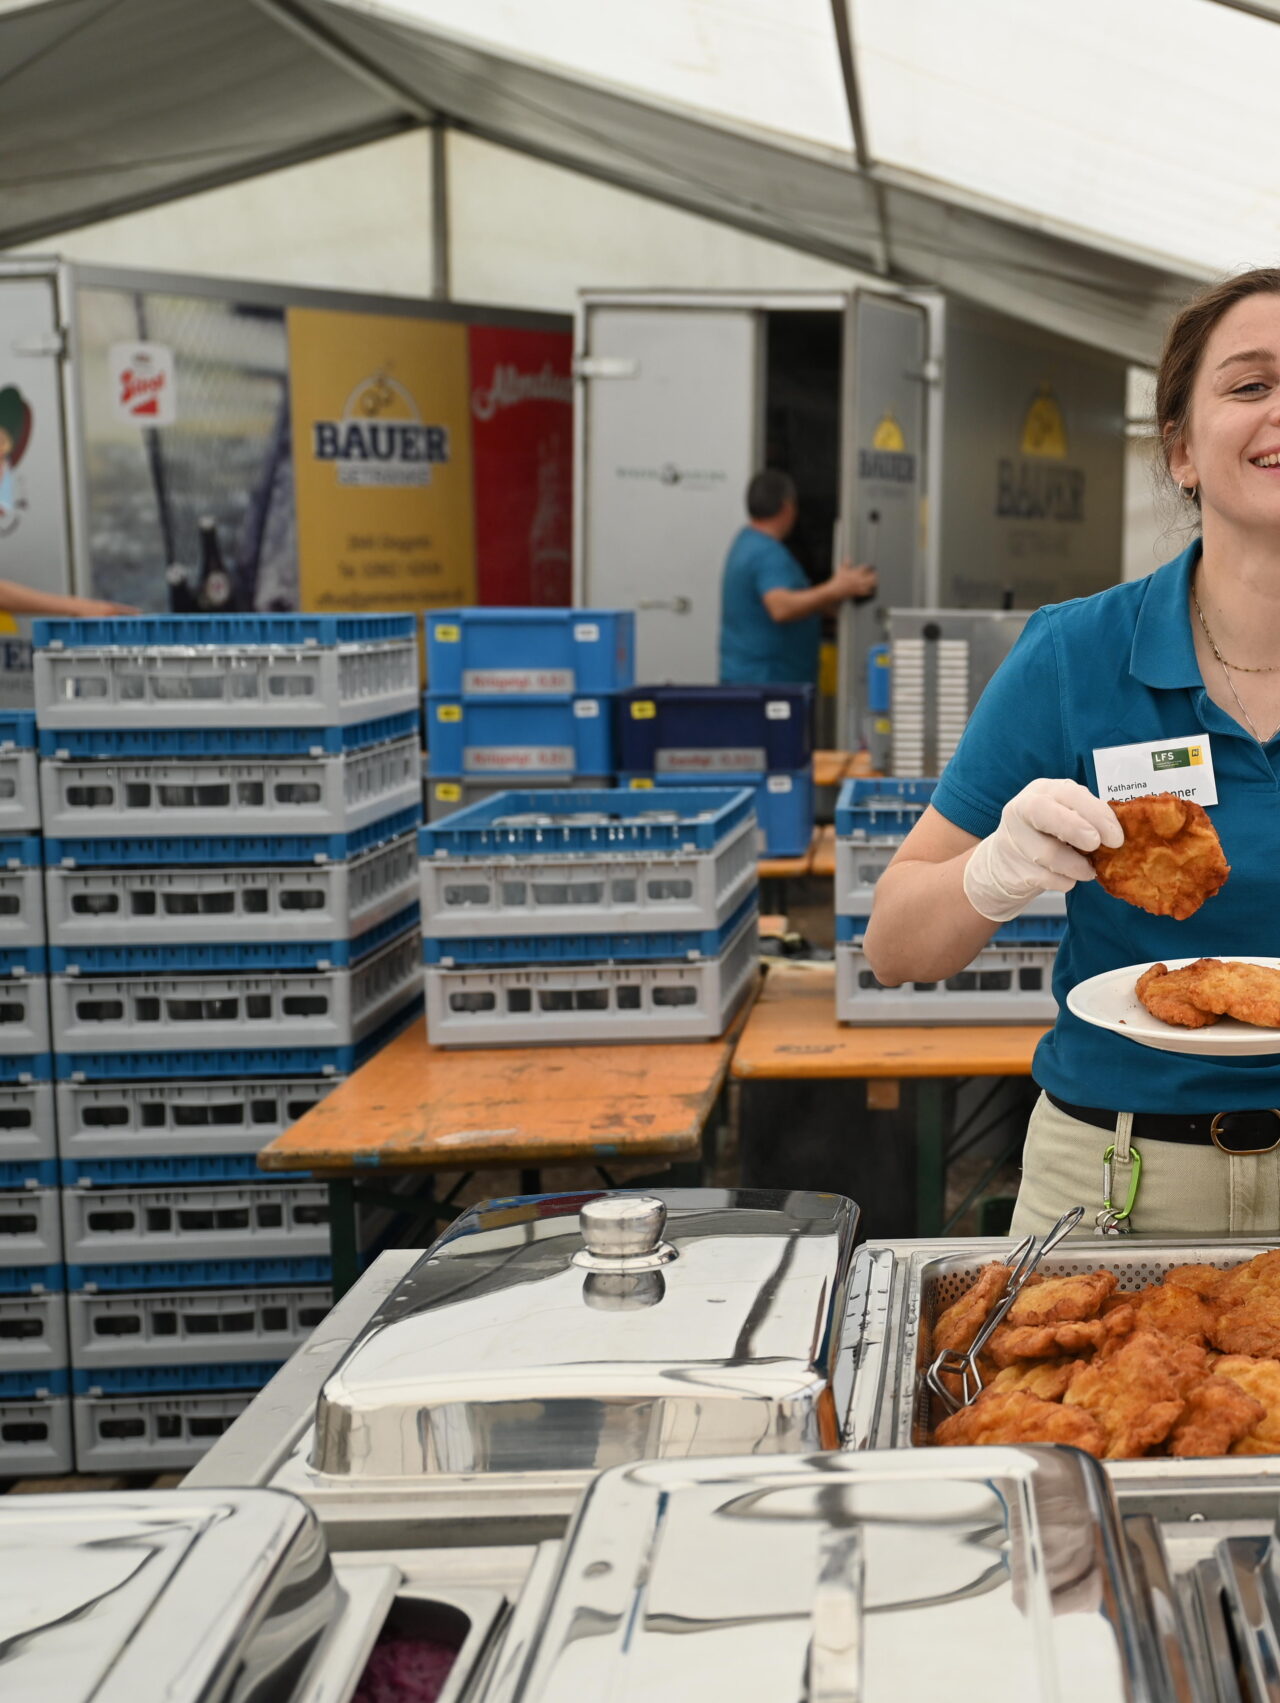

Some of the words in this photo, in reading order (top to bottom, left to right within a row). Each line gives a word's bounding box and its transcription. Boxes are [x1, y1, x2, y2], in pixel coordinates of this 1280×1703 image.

[315, 420, 449, 464] BAUER
[1154, 751, 1174, 763] LFS
[1107, 781, 1148, 793] Katharina
